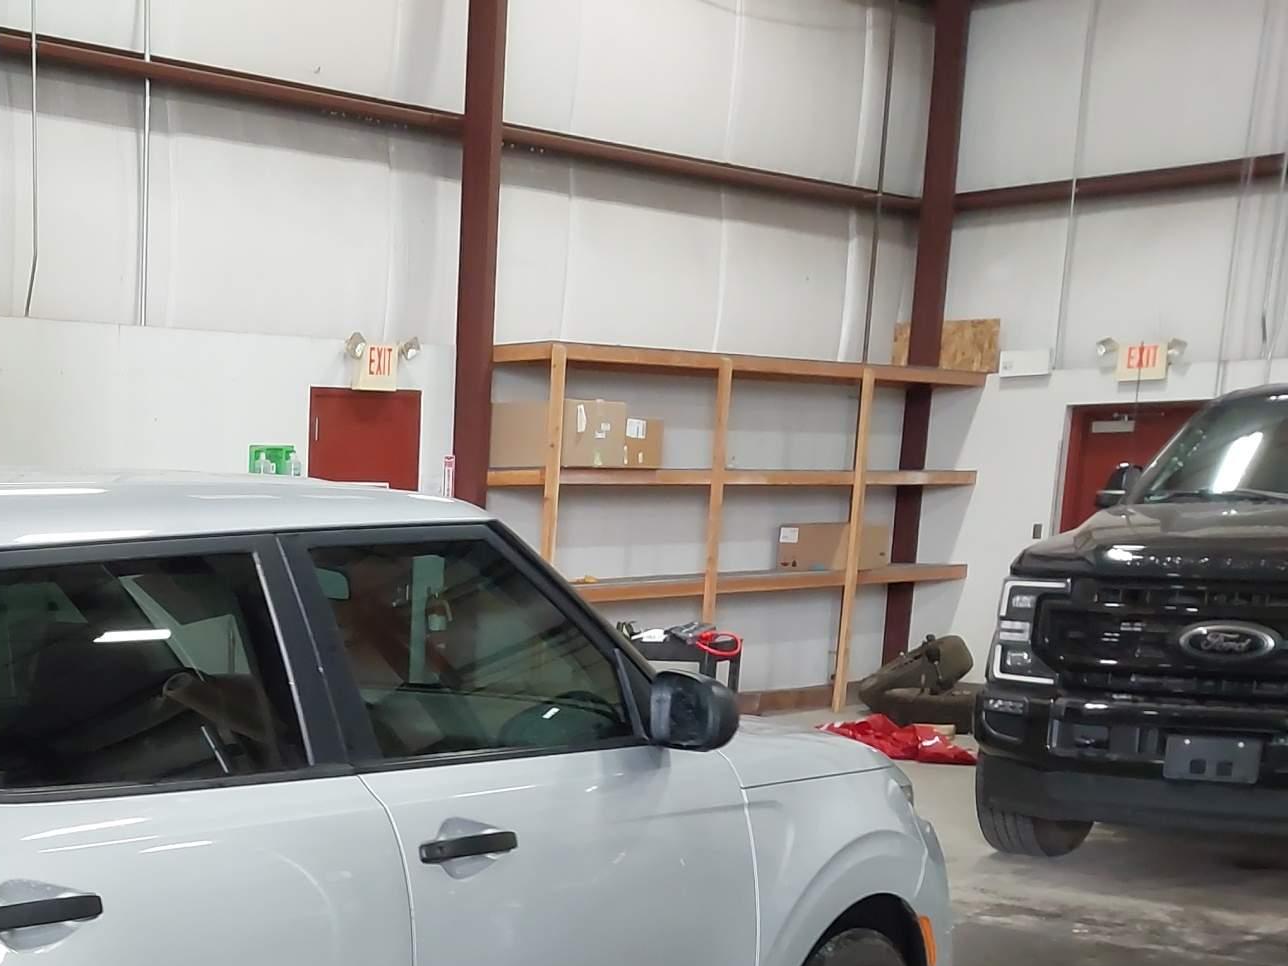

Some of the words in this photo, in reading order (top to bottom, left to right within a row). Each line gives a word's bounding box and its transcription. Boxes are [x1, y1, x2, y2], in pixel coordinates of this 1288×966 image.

[368, 346, 393, 376] EXIT
[1126, 345, 1159, 369] EXIT
[1200, 631, 1252, 652] Ford
